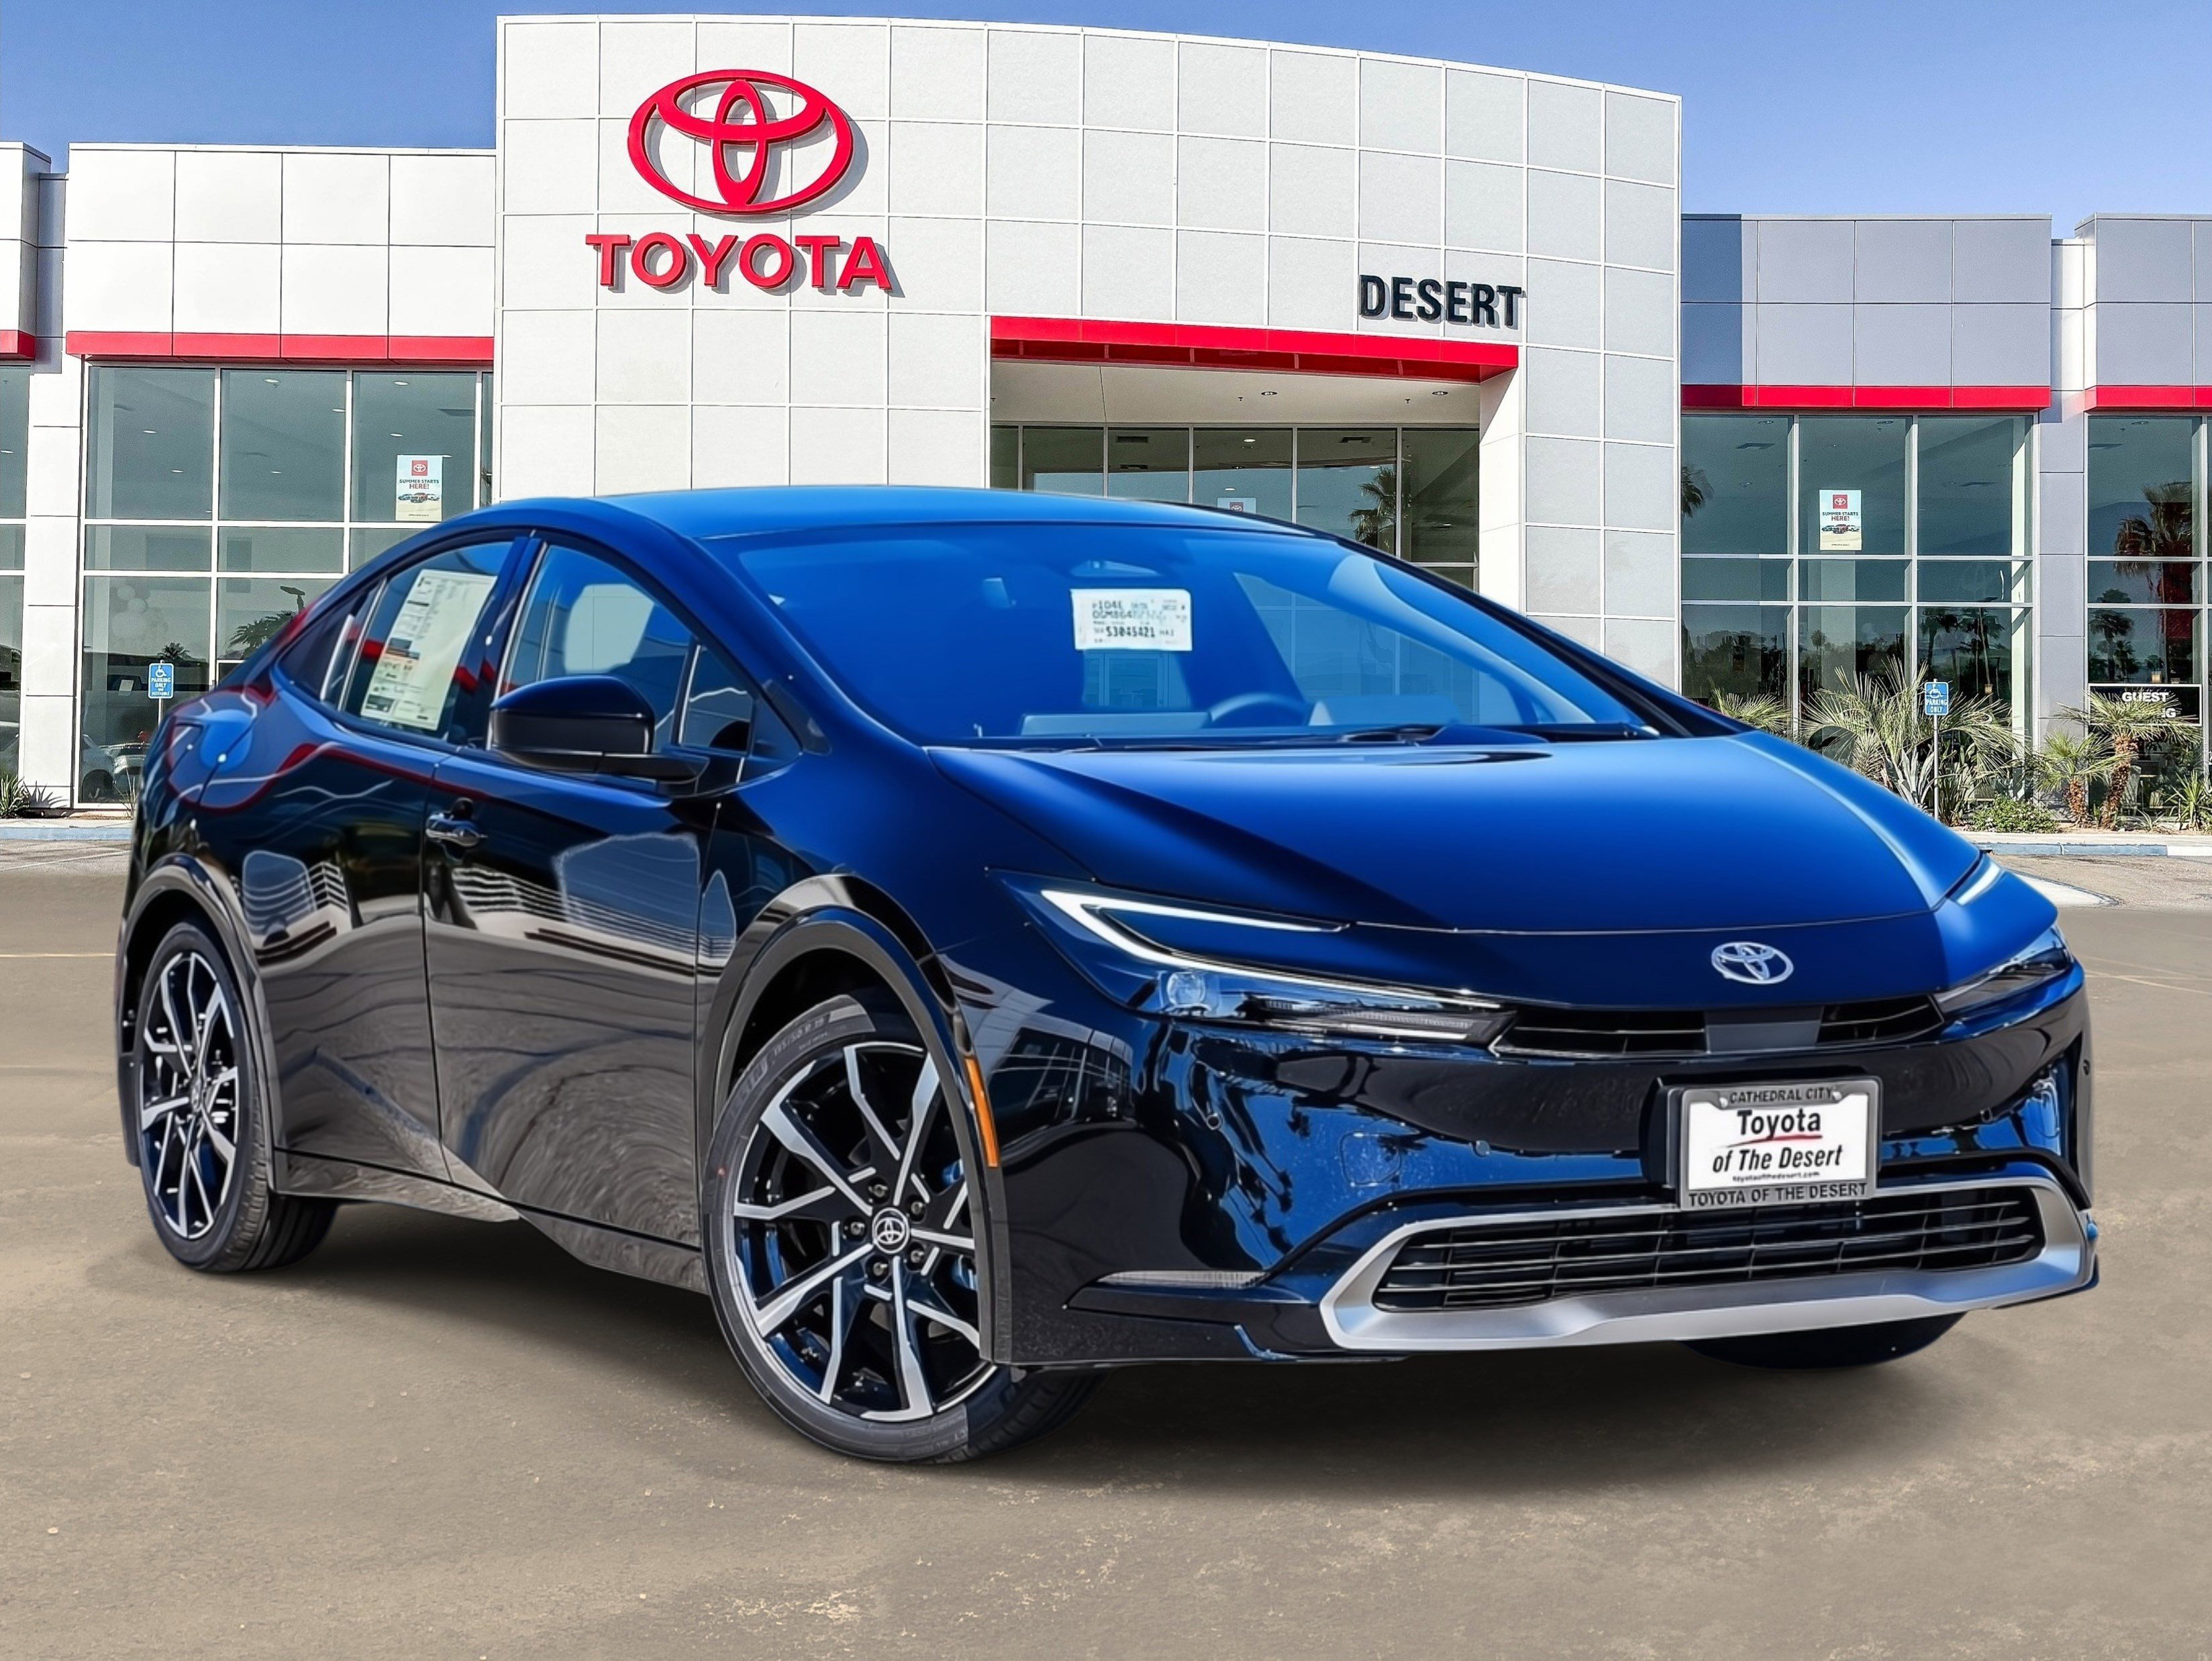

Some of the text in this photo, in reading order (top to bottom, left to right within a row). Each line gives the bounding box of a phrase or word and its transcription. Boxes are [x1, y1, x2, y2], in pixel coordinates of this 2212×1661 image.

[585, 232, 891, 291] TOYOTA
[1359, 274, 1522, 326] DESERT
[2121, 692, 2169, 702] GUEST
[1729, 1087, 1832, 1104] CATHEDRAL CITY
[1737, 1108, 1821, 1140] Toyota
[1713, 1144, 1843, 1173] of The Desert
[1689, 1182, 1868, 1207] TOYOTA OF THE DESERT
